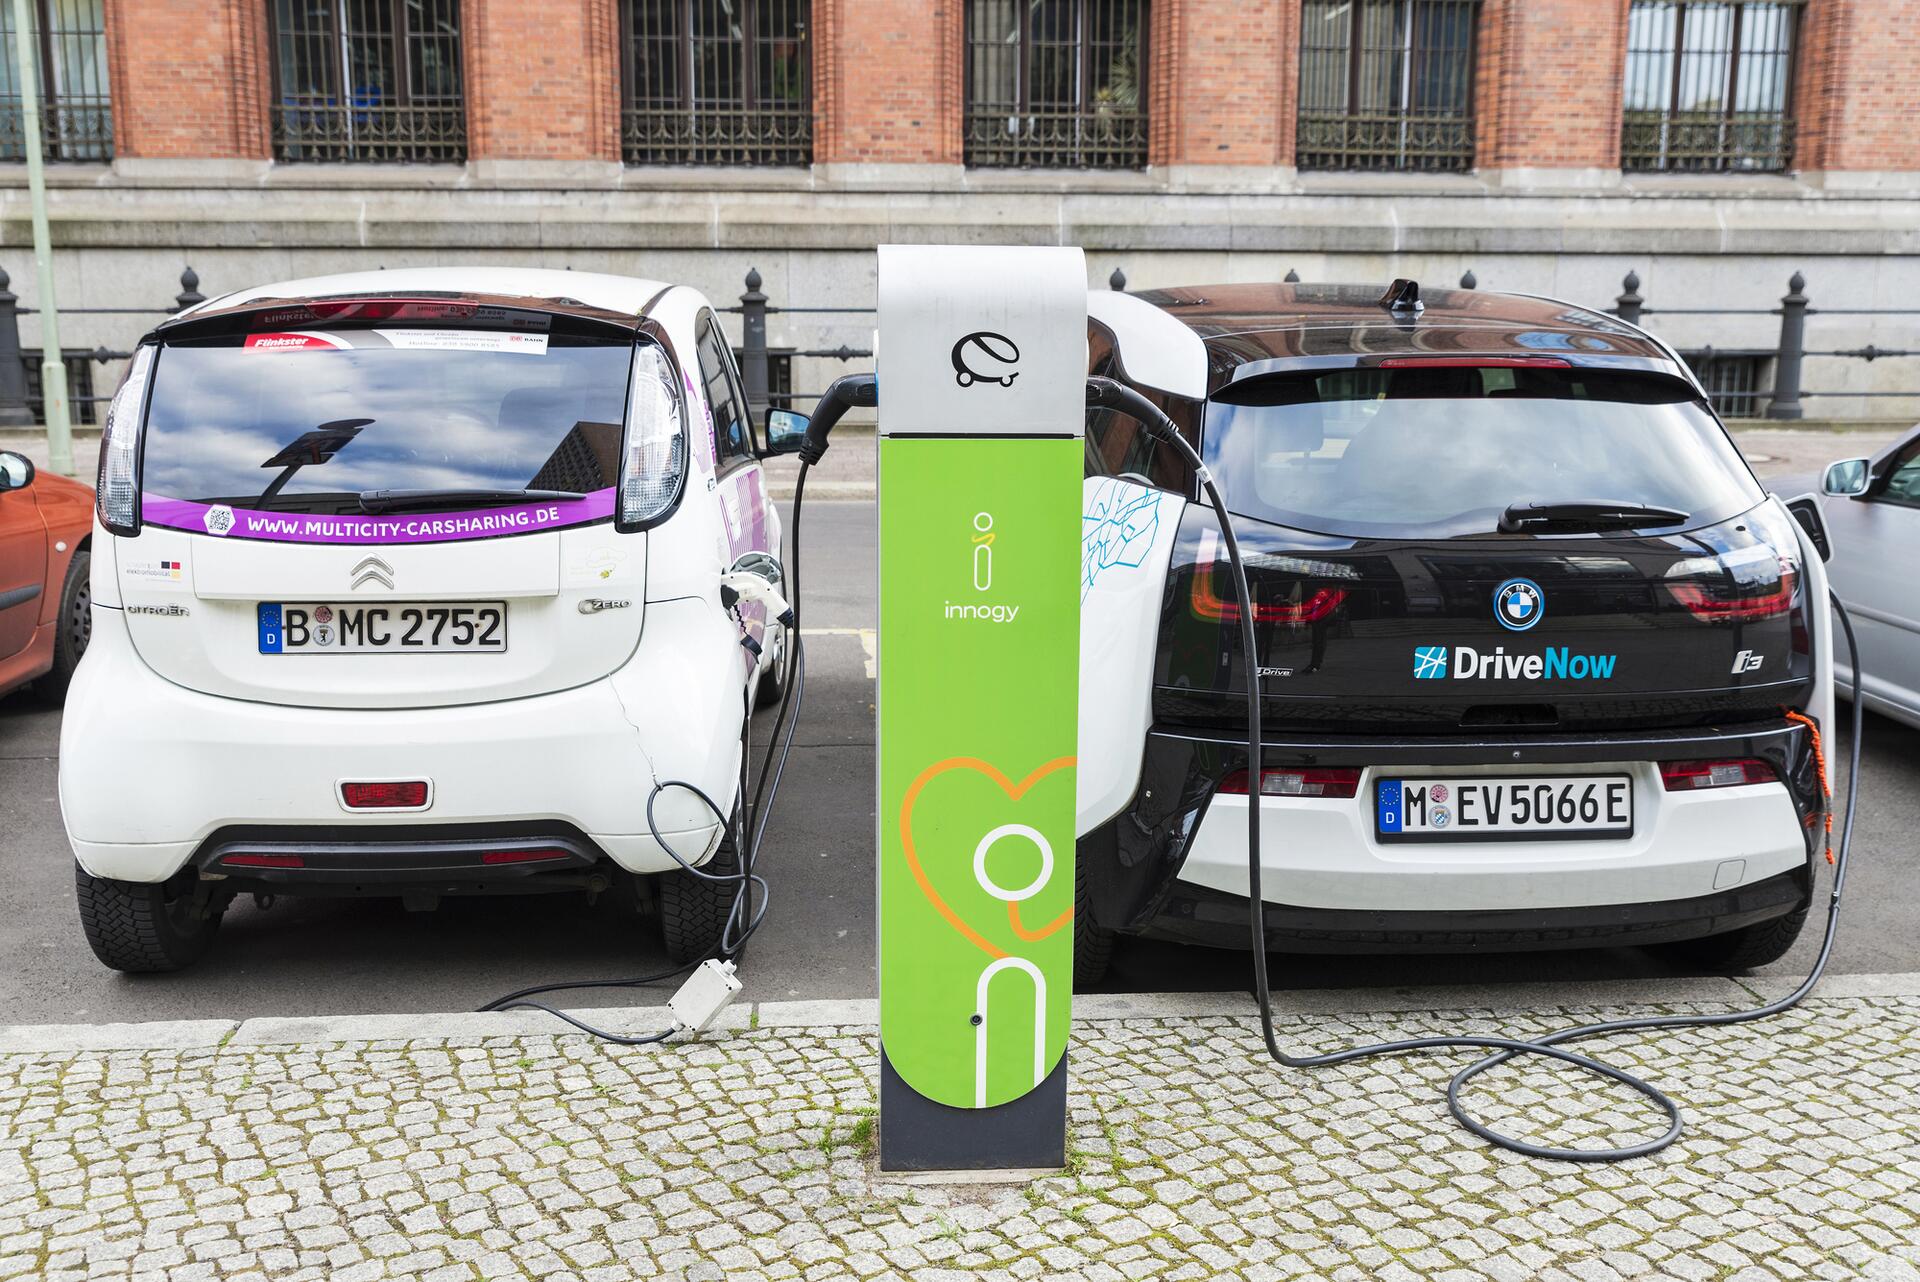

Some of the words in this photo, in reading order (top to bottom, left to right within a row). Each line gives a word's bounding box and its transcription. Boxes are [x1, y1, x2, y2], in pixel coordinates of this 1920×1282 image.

[255, 338, 309, 347] Flinkster
[247, 507, 561, 537] WWW.MULTICITY-CARSHARING.DE
[1503, 585, 1537, 599] BMW
[945, 600, 1020, 623] innogy
[267, 633, 276, 644] D
[286, 609, 310, 647] B
[339, 609, 391, 647] MC
[401, 608, 501, 647] 2752
[1257, 667, 1292, 677] Drive
[1453, 646, 1617, 680] DriveNow
[1731, 650, 1764, 674] i3
[1386, 812, 1395, 823] D
[1404, 786, 1427, 826] M
